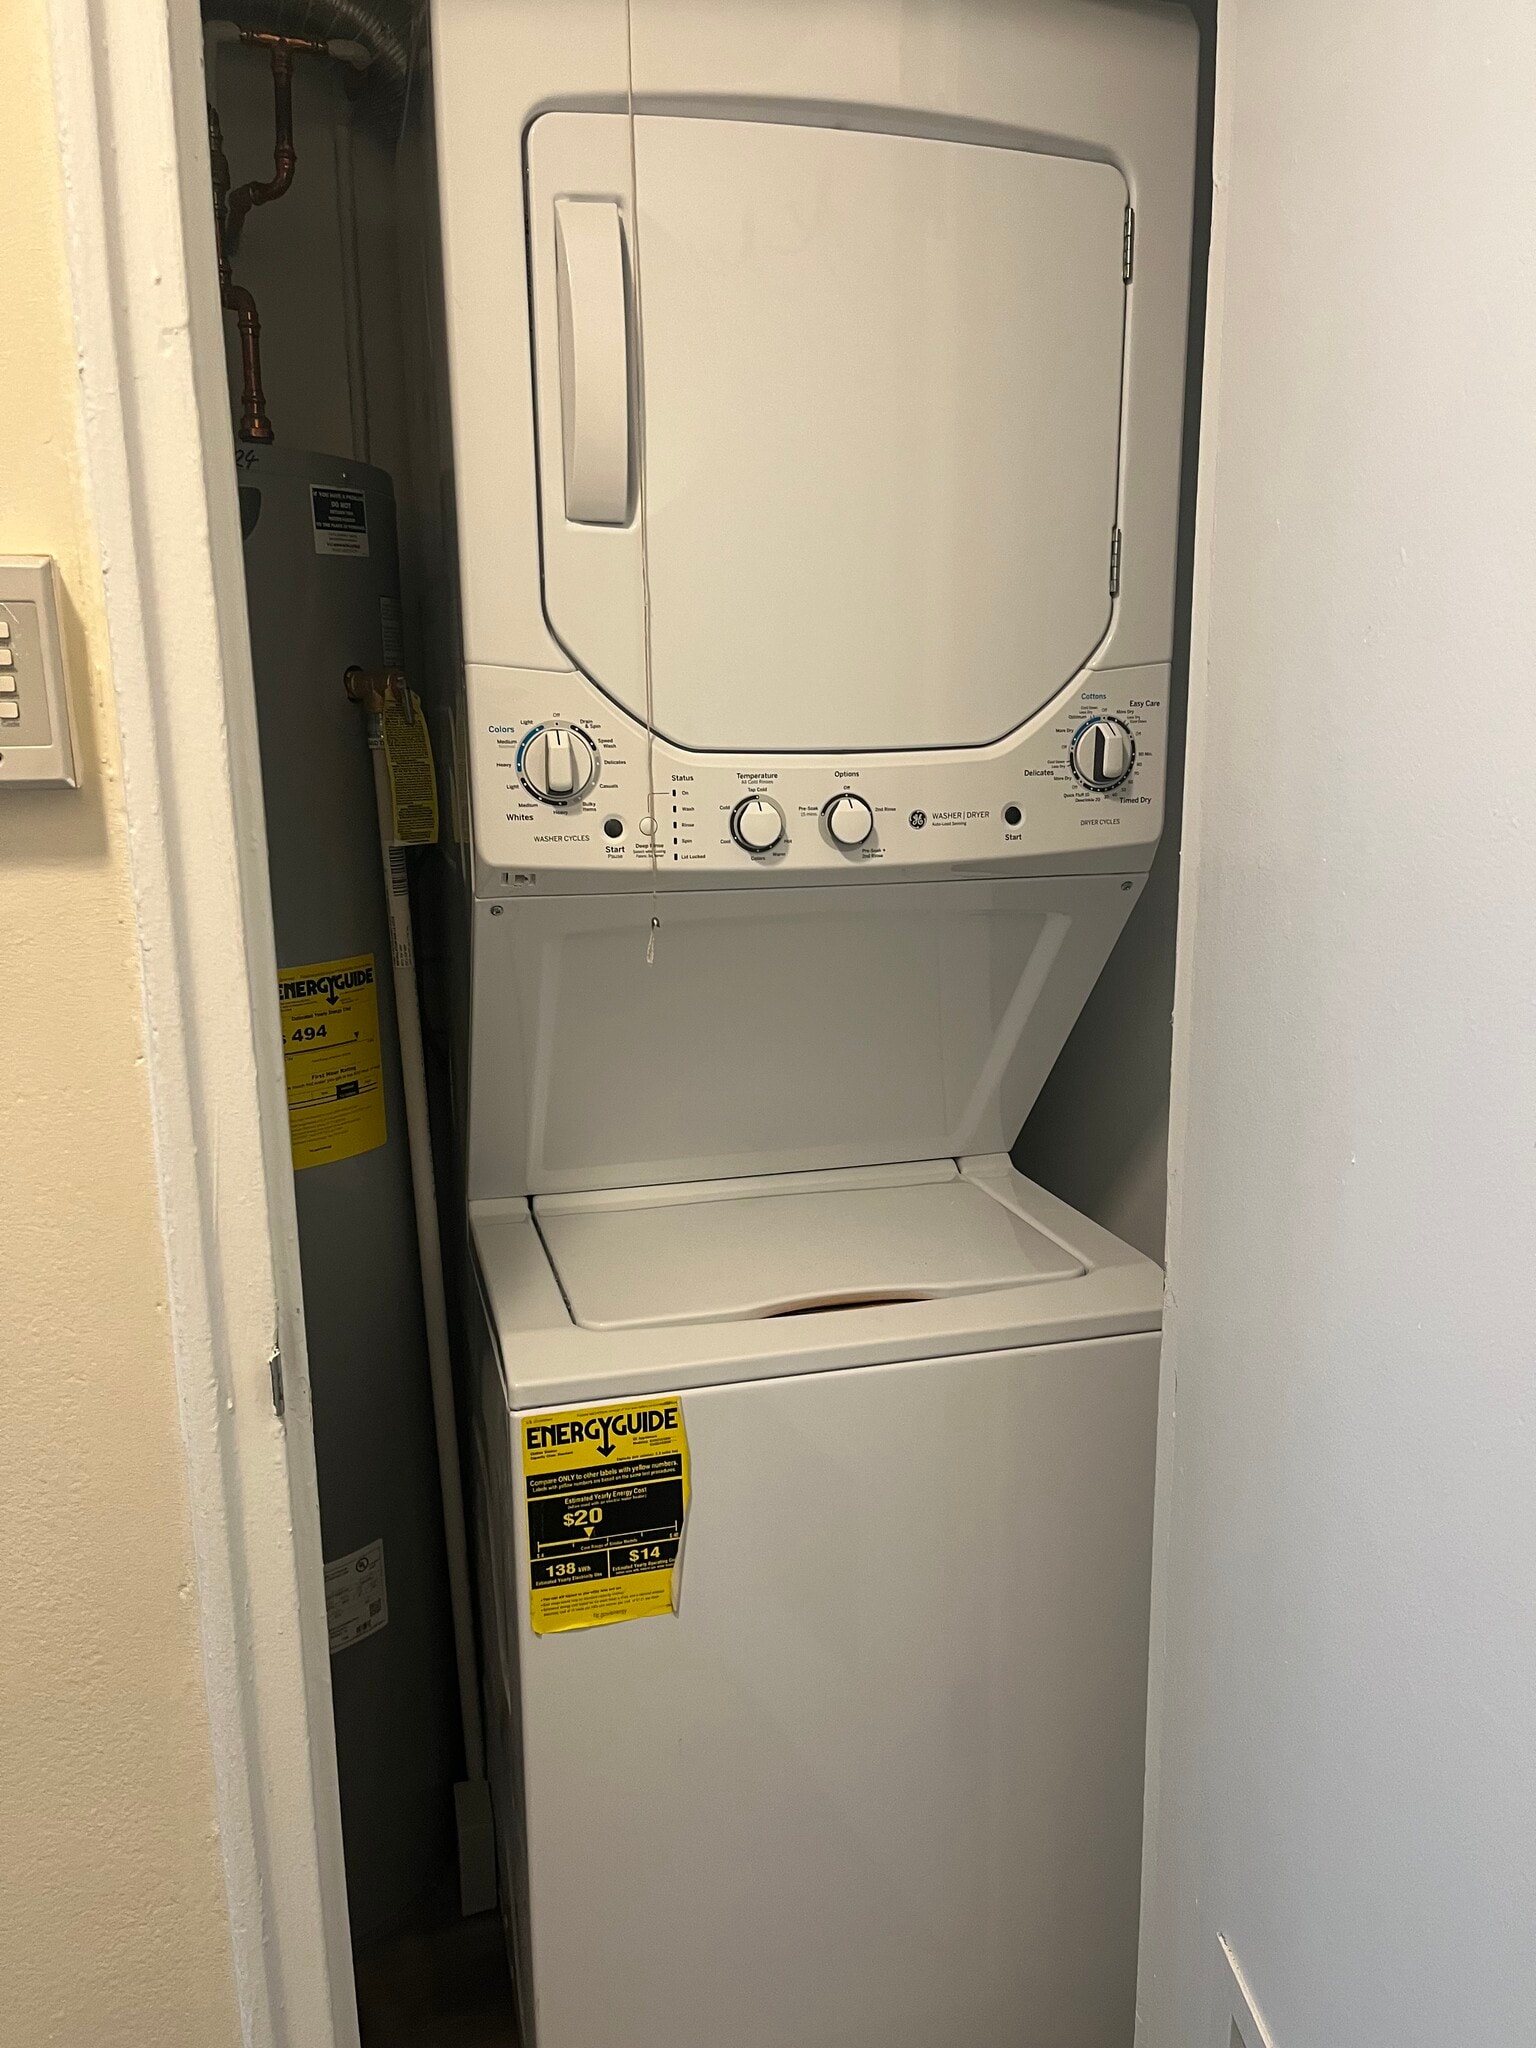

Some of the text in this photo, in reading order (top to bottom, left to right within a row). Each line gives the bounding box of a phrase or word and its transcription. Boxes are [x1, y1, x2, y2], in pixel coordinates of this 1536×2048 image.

[292, 1024, 327, 1042] 494
[327, 1070, 339, 1078] Hour
[341, 1066, 357, 1075] Rating
[527, 1408, 678, 1449] ENERGYGUIDE
[530, 1477, 557, 1487] Compare
[600, 1468, 617, 1476] labels
[619, 1466, 631, 1474] with
[632, 1464, 650, 1473] yellow
[652, 1460, 678, 1468] numbers.
[564, 1494, 593, 1505] Estimated
[594, 1490, 611, 1500] Yearly
[612, 1489, 632, 1498] Energy
[563, 1508, 602, 1526] $20
[629, 1546, 660, 1562] $14
[546, 1563, 576, 1577] 138
[648, 1558, 668, 1567] Operating
[536, 1577, 556, 1586] Estimated
[558, 1576, 571, 1584] Yearly
[572, 1573, 593, 1582] Electricity
